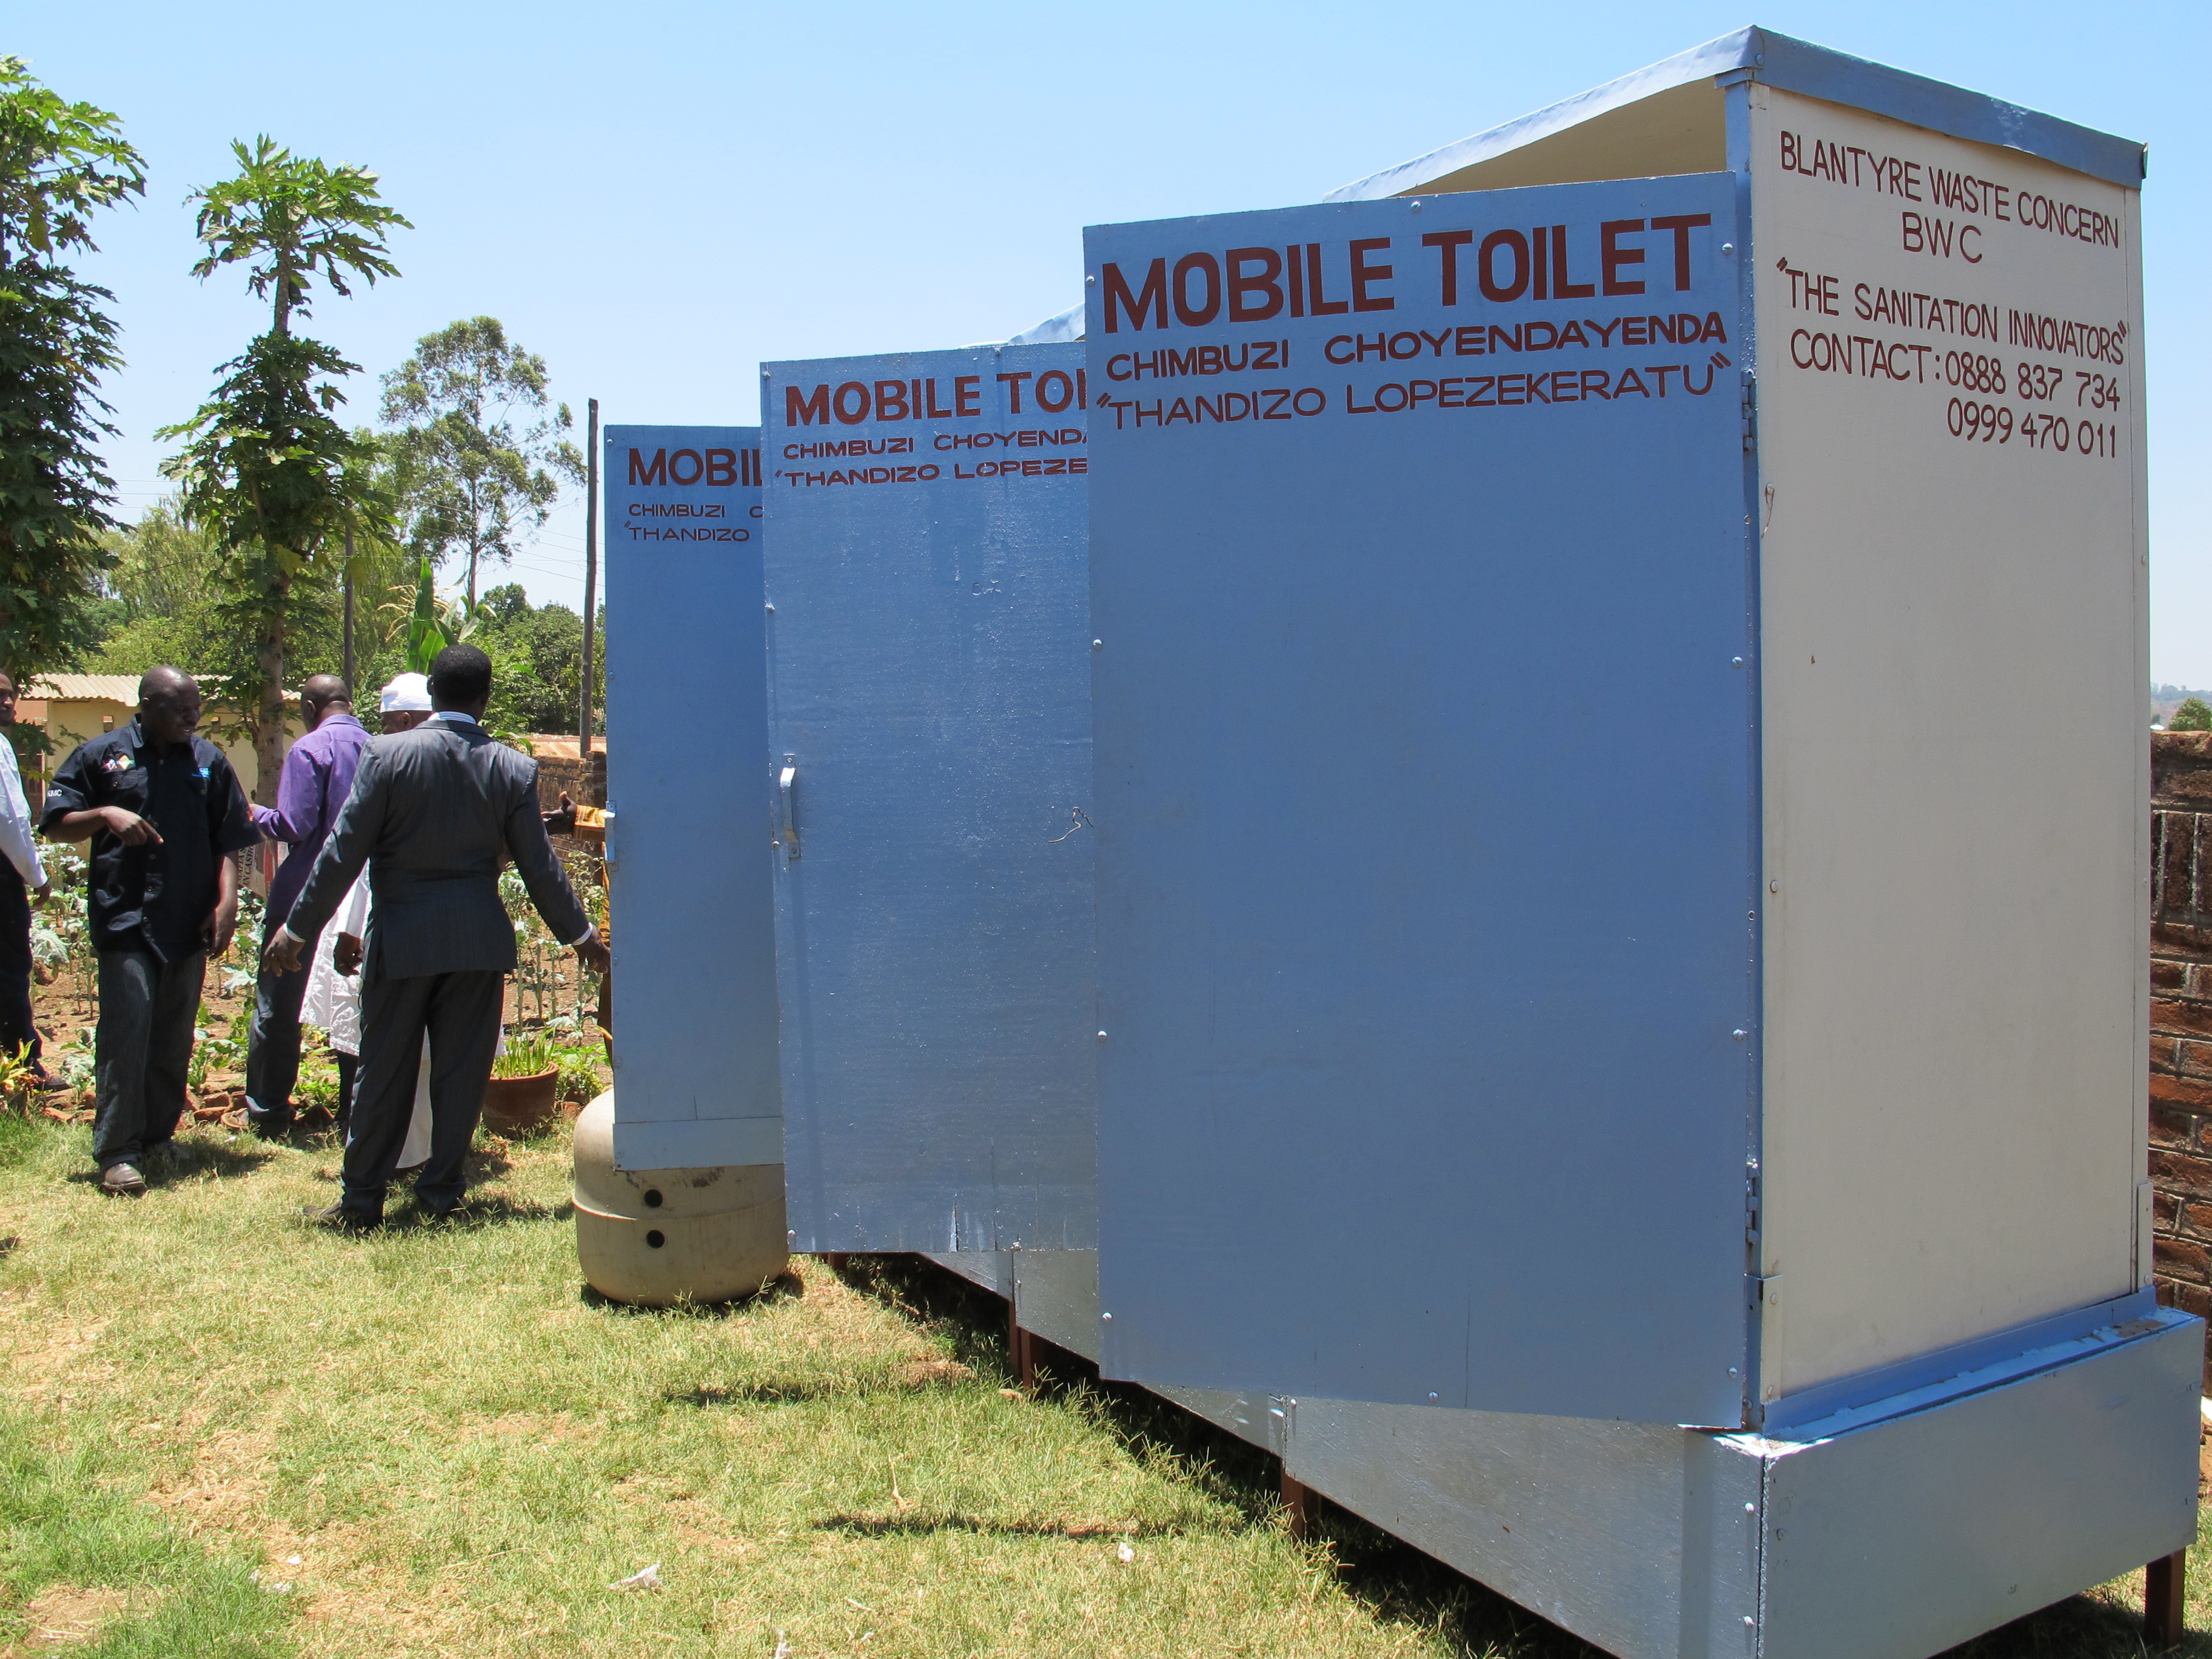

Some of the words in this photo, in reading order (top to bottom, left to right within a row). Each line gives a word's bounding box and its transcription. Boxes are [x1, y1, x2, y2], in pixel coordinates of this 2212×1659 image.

[1780, 131, 1922, 202] BLANTYRE
[1929, 166, 2010, 221] WASTE
[2017, 192, 2119, 249] CONCERN
[1902, 212, 1982, 263] BWC
[1102, 237, 1395, 334] MOBILE
[1422, 213, 1712, 307] TOILET
[1854, 283, 1997, 343] SANITATION
[1107, 339, 1289, 381] CHIMBUZI
[1324, 311, 1727, 365] CHOYENDAYENDA
[786, 377, 981, 426] MOBILE
[2017, 363, 2062, 401] 837
[2075, 371, 2120, 412] 734
[783, 437, 914, 460] CHIMBUZI
[934, 429, 1087, 451] CHOYEND
[1947, 397, 2013, 444] 0999
[2020, 412, 2070, 452] 470
[2077, 421, 2116, 458] 011
[628, 504, 725, 518] CHIMBUZI
